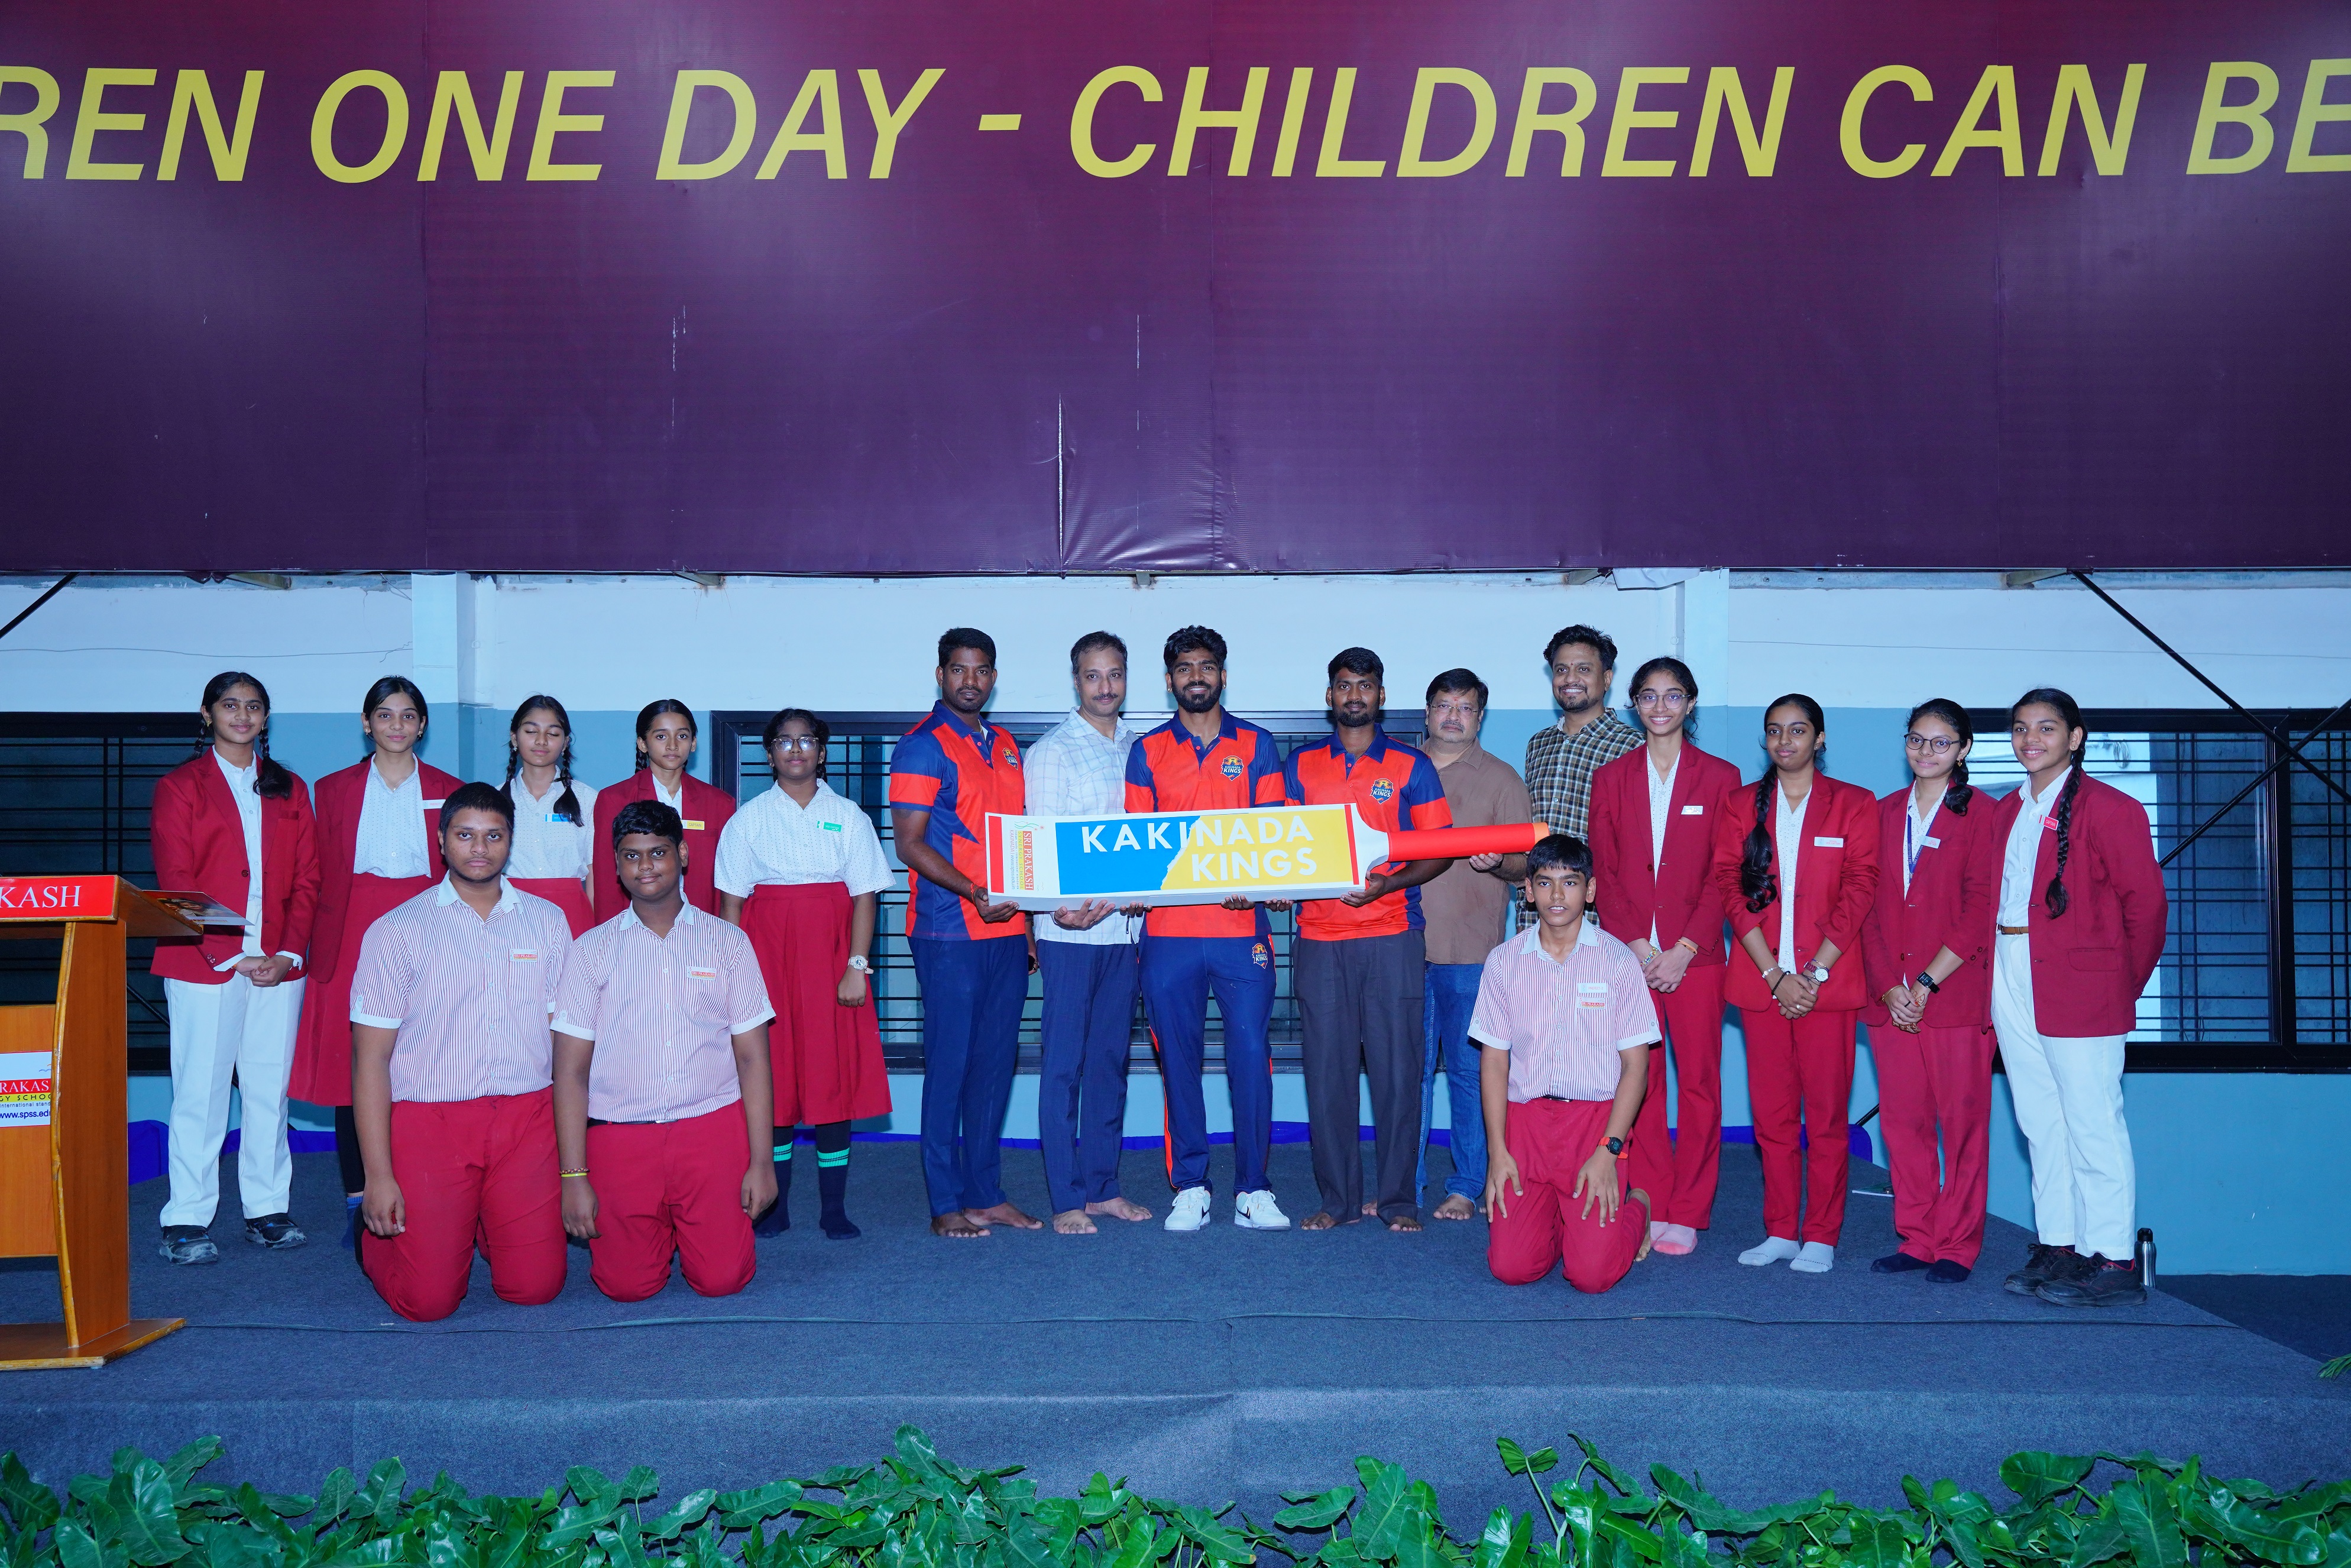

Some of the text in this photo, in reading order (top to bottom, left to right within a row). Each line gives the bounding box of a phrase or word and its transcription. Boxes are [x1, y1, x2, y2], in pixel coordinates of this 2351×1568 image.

[0, 59, 2351, 183] REN ONE DAY - CHILDREN CAN BE
[1081, 815, 1314, 853] KAKINADA
[2046, 819, 2056, 827] CAPTAIN
[1024, 832, 1033, 889] SRI PRAKASH
[1191, 847, 1317, 882] KINGS
[0, 886, 82, 908] KASH
[0, 1080, 49, 1093] RAKAS
